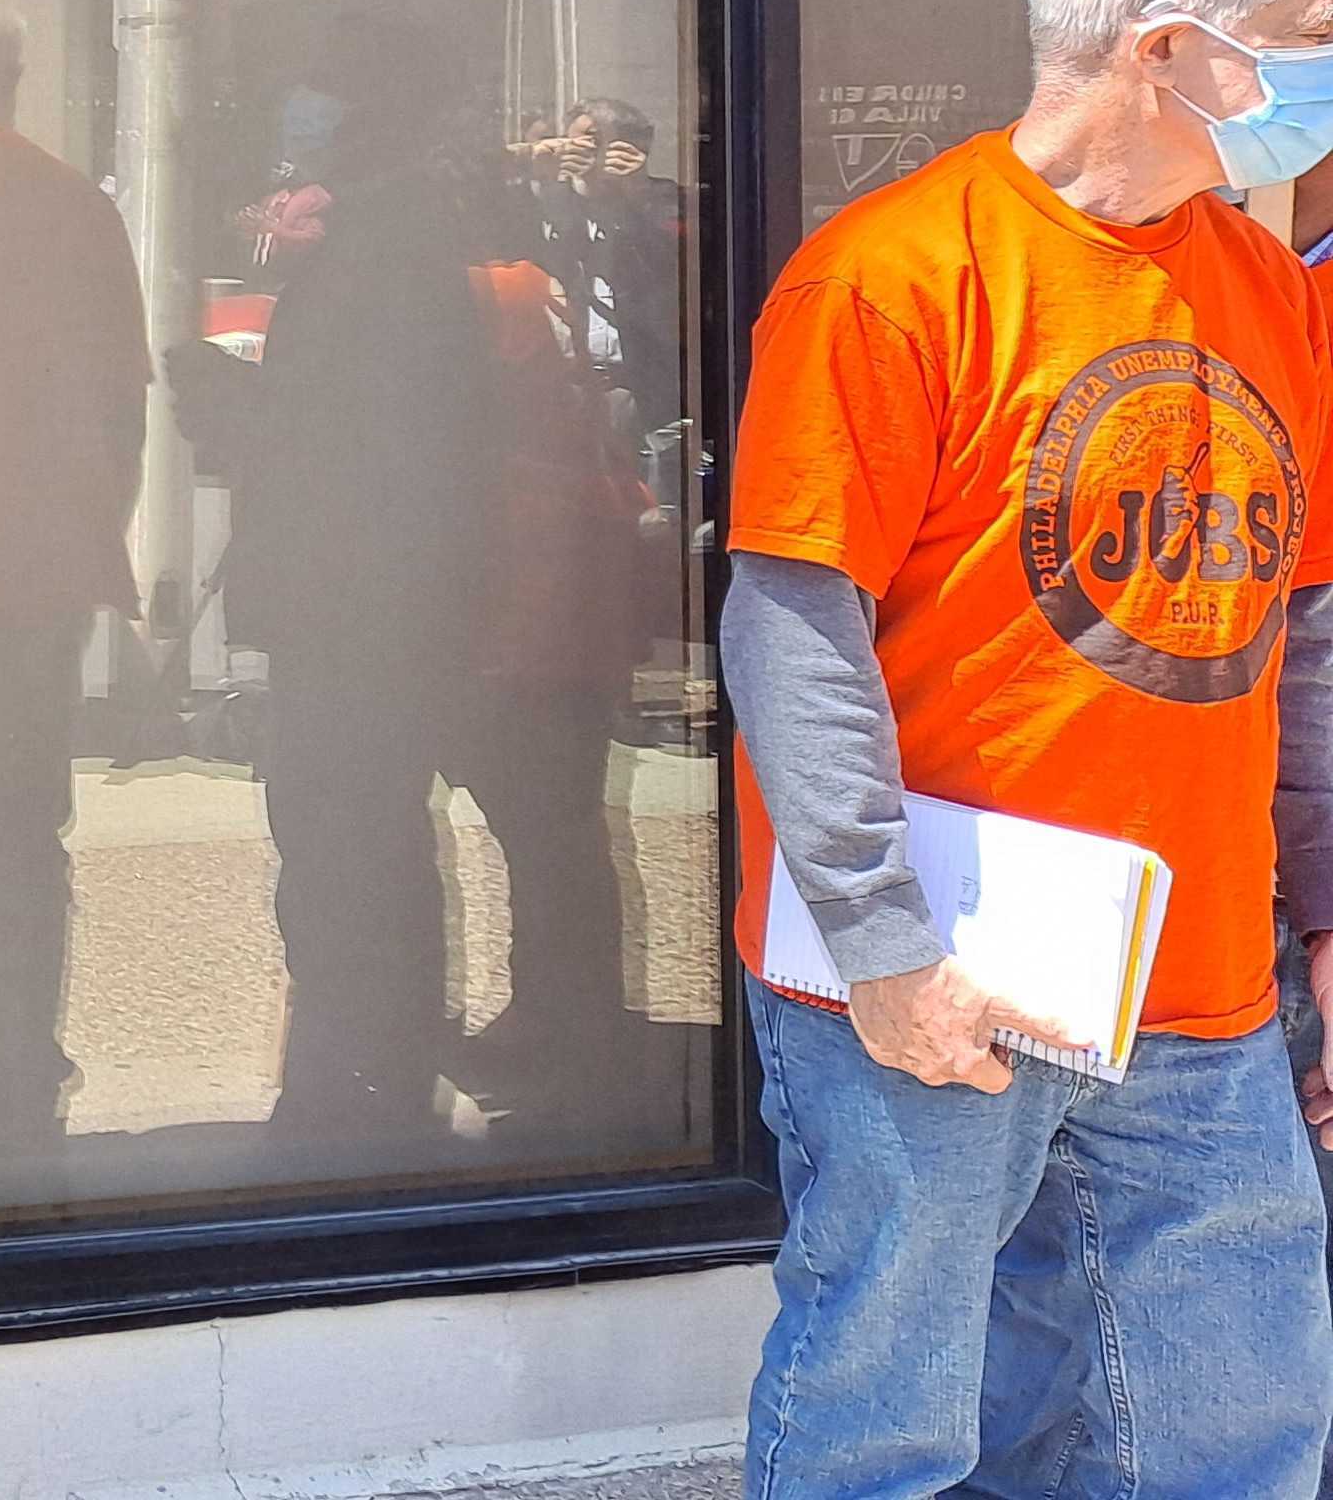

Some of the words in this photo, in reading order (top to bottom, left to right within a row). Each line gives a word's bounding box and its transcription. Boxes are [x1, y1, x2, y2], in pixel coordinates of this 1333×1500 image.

[1031, 374, 1111, 592] PHILADELPHIA
[1107, 350, 1289, 446] UNEMPLOYMENT
[1109, 419, 1145, 467] FIRST
[1090, 489, 1282, 583] JOBS
